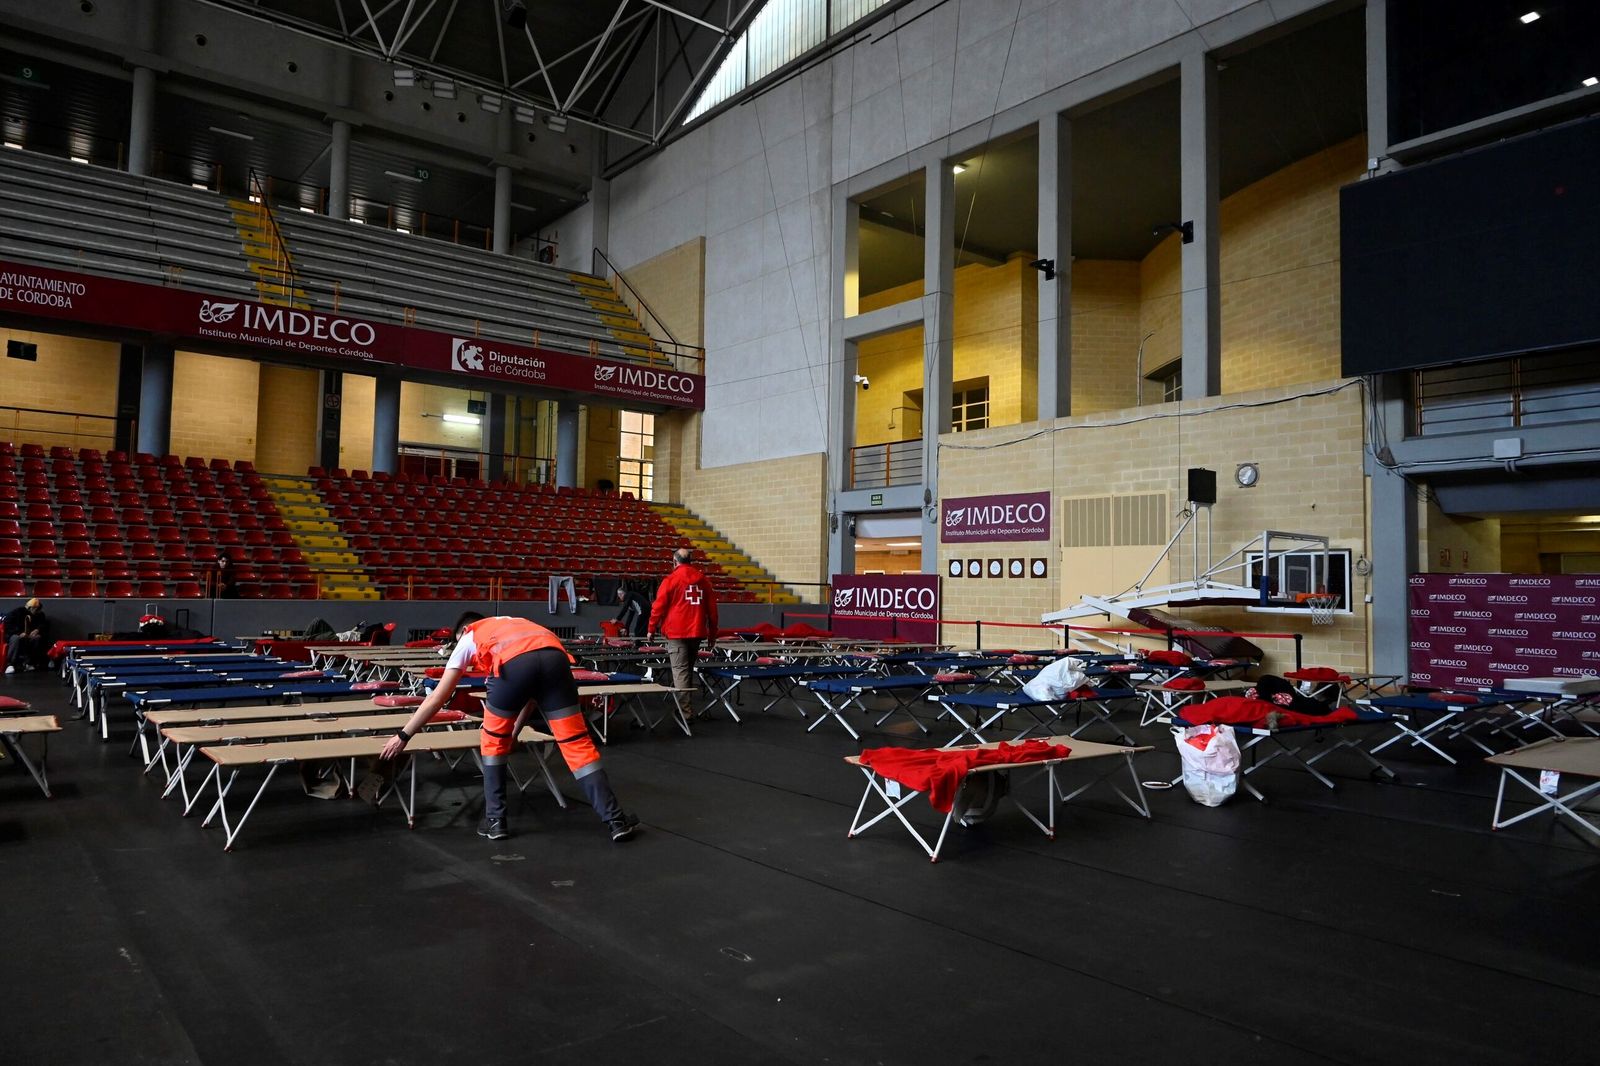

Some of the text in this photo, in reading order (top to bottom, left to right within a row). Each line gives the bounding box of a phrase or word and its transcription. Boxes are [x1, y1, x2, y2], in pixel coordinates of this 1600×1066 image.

[23, 67, 33, 79] 9
[417, 169, 429, 179] 10
[0, 272, 86, 296] AYUNTAMIENTO
[0, 286, 73, 309] DE CÓRDOBA
[242, 303, 376, 346] IMDECO
[199, 326, 374, 359] Instituto Municipal de Deportes Córdoba
[489, 351, 546, 369] Diputación
[488, 363, 546, 380] de Córdoba
[618, 366, 694, 394] IMDECO
[594, 383, 616, 392] Instituto
[616, 386, 641, 396] Municipal
[650, 391, 673, 401] Deportes
[967, 502, 1046, 525] IMDECO
[965, 528, 989, 537] Municipal
[997, 527, 1021, 536] Deportes
[1021, 526, 1045, 534] Córdoba
[856, 587, 935, 610] IMDECO
[854, 609, 878, 618] Municipal
[1562, 631, 1596, 639] IMDECO
[1463, 644, 1493, 652] IMDECO
[1524, 648, 1557, 656] IMDECO
[1438, 659, 1467, 667] IMDECO
[1497, 663, 1529, 671] IMDECO
[1562, 667, 1597, 675] IMDECO
[1463, 677, 1494, 685] IMDECO
